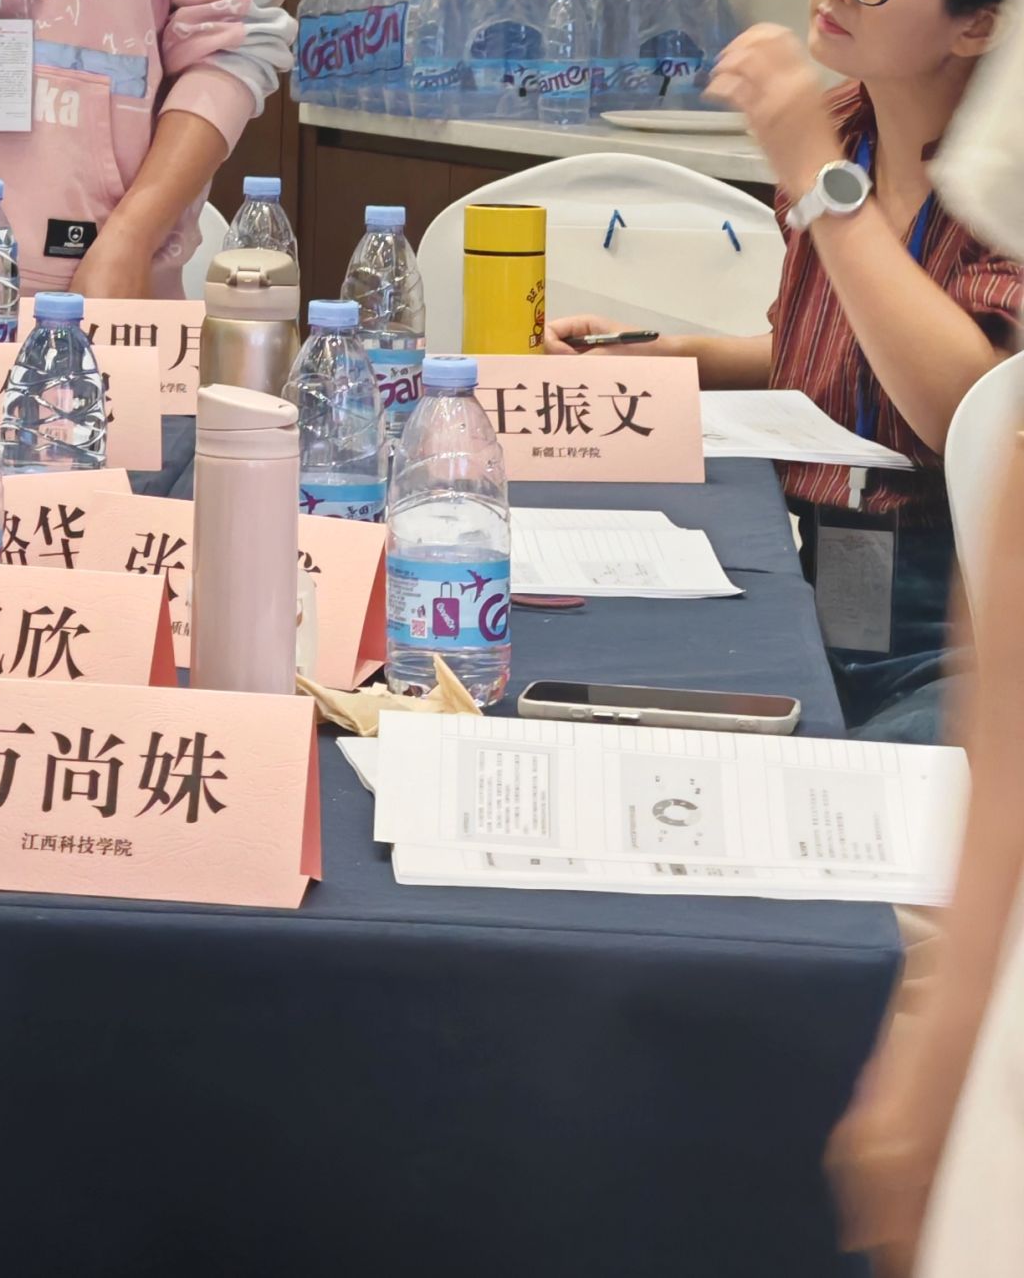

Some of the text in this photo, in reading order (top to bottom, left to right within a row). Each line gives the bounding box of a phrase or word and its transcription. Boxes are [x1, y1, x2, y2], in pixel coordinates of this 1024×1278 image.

[476, 381, 655, 437] 王振文
[531, 447, 602, 459] 新疆工程学院
[21, 832, 134, 857] 江西科技学院
